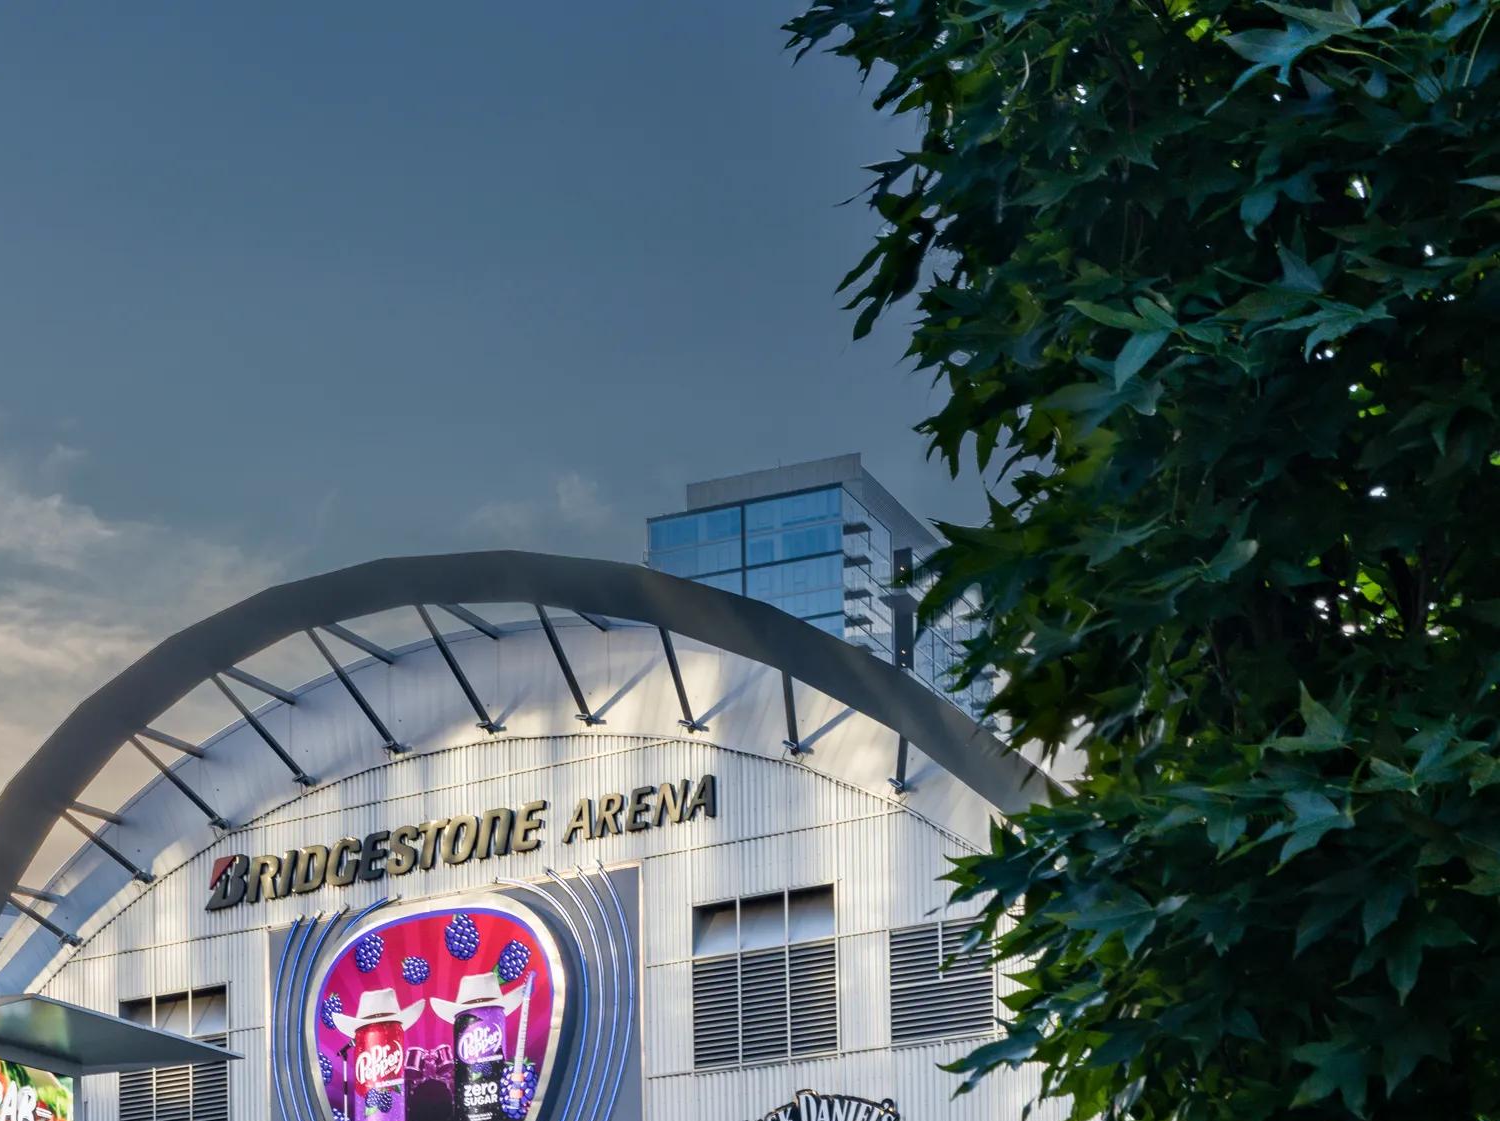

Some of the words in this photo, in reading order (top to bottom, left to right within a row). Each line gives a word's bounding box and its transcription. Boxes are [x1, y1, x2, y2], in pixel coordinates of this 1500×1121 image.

[206, 799, 548, 910] BRIDGESTONE
[562, 773, 717, 844] ARENA
[370, 1044, 391, 1060] Dr
[464, 1081, 498, 1097] zero
[463, 1094, 498, 1107] SUGAR
